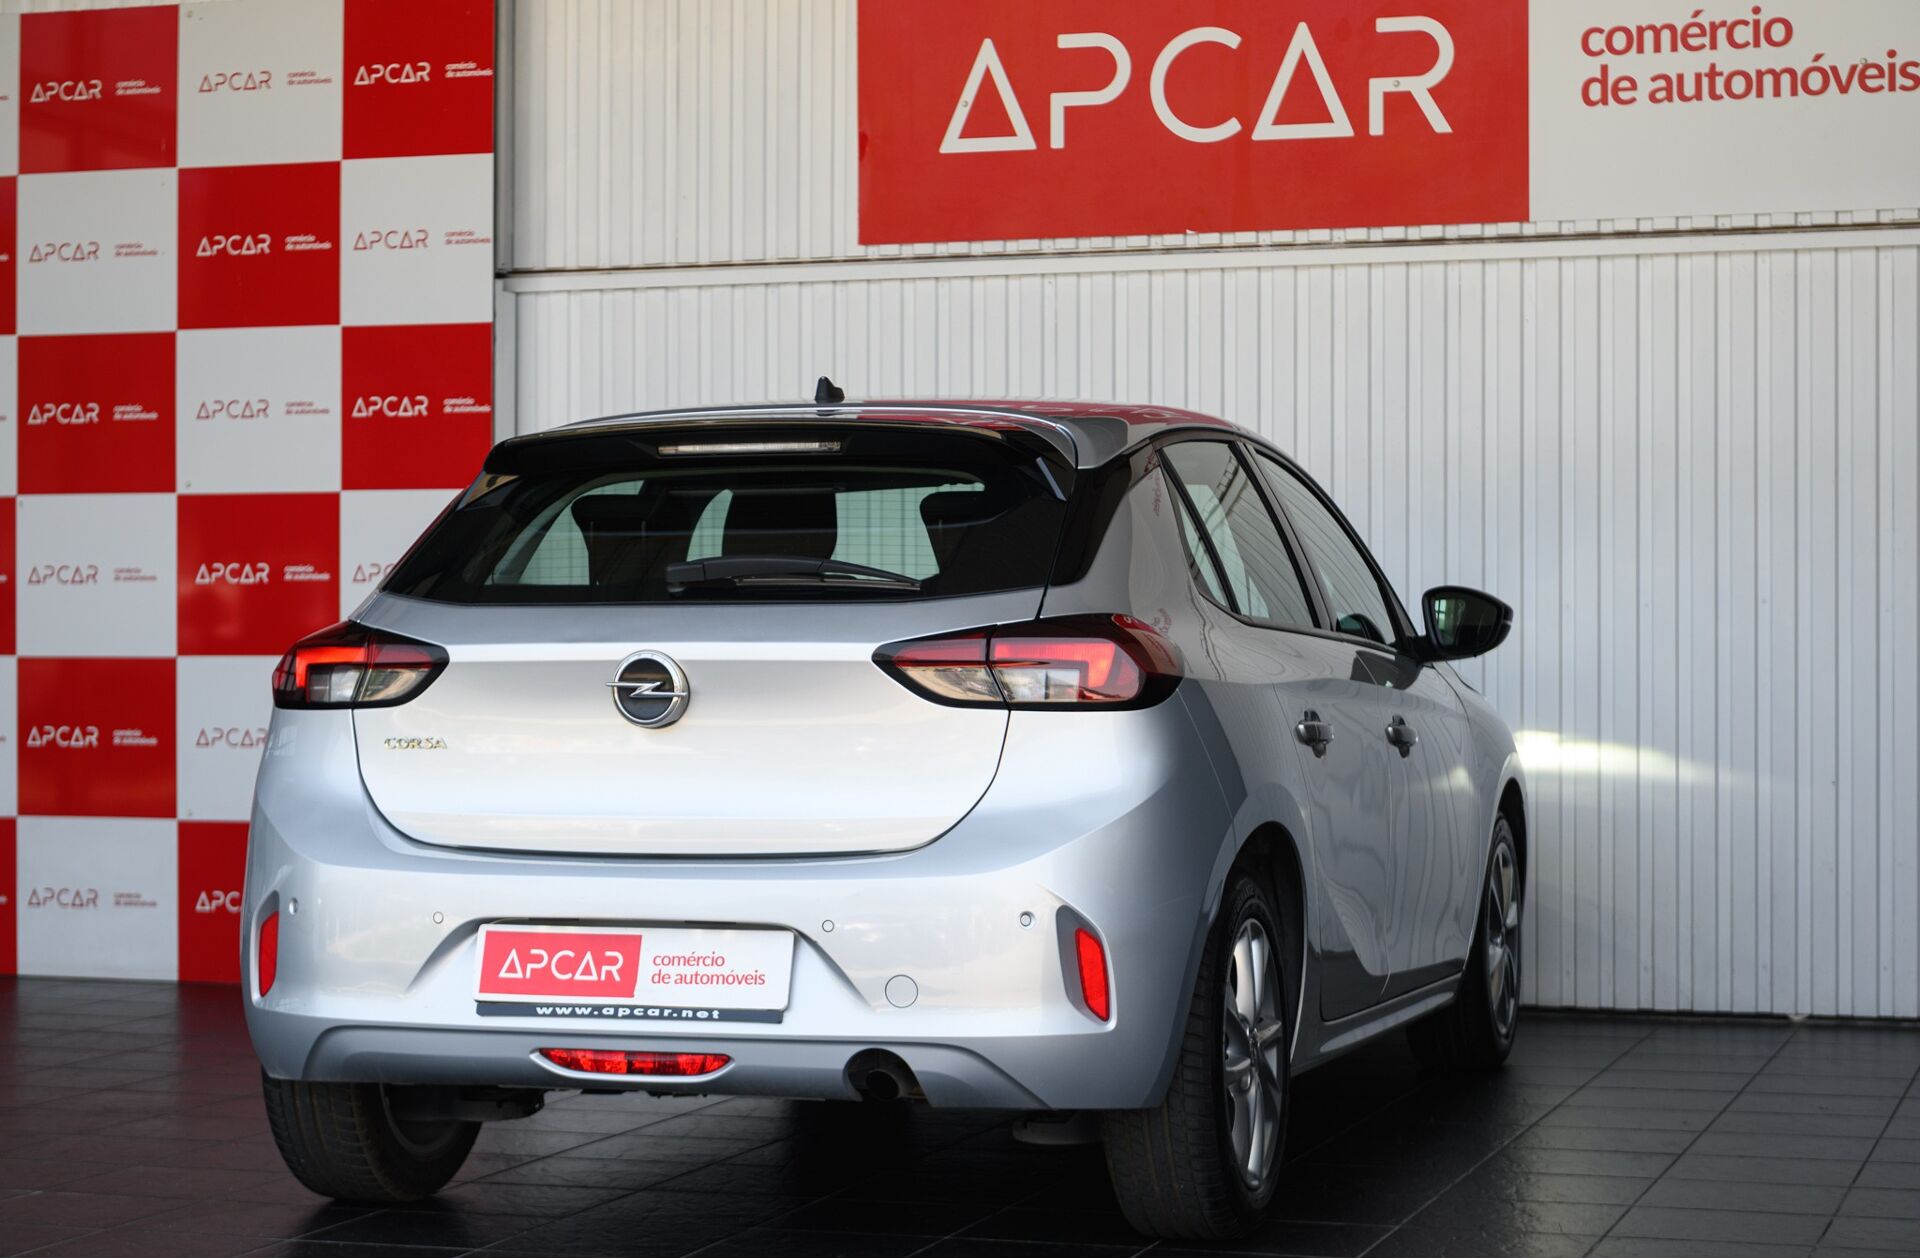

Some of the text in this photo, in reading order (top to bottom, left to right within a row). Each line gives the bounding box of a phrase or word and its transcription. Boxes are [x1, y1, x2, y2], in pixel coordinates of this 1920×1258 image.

[1580, 5, 1794, 57] comércio
[198, 70, 272, 93] APCAR
[353, 62, 431, 86] APCAR
[939, 16, 1455, 153] APCAR
[1580, 49, 1920, 107] de automóveis
[30, 79, 103, 103] APCAR
[196, 233, 271, 257] APCAR
[353, 229, 429, 251] APCAR
[29, 241, 100, 263] APCAR
[28, 402, 100, 425] APCAR
[196, 399, 270, 420] APCAR
[351, 395, 429, 418] APCAR
[27, 564, 99, 585] APCAR
[195, 563, 270, 584] APCAR
[27, 725, 99, 748] APCAR
[384, 737, 448, 750] CORSA
[27, 887, 99, 909] APCAR
[195, 890, 241, 913] APC
[498, 948, 624, 982] APCAR
[652, 951, 725, 967] comércio
[651, 968, 766, 985] de automóveis
[535, 1005, 720, 1019] www.apcar.net
